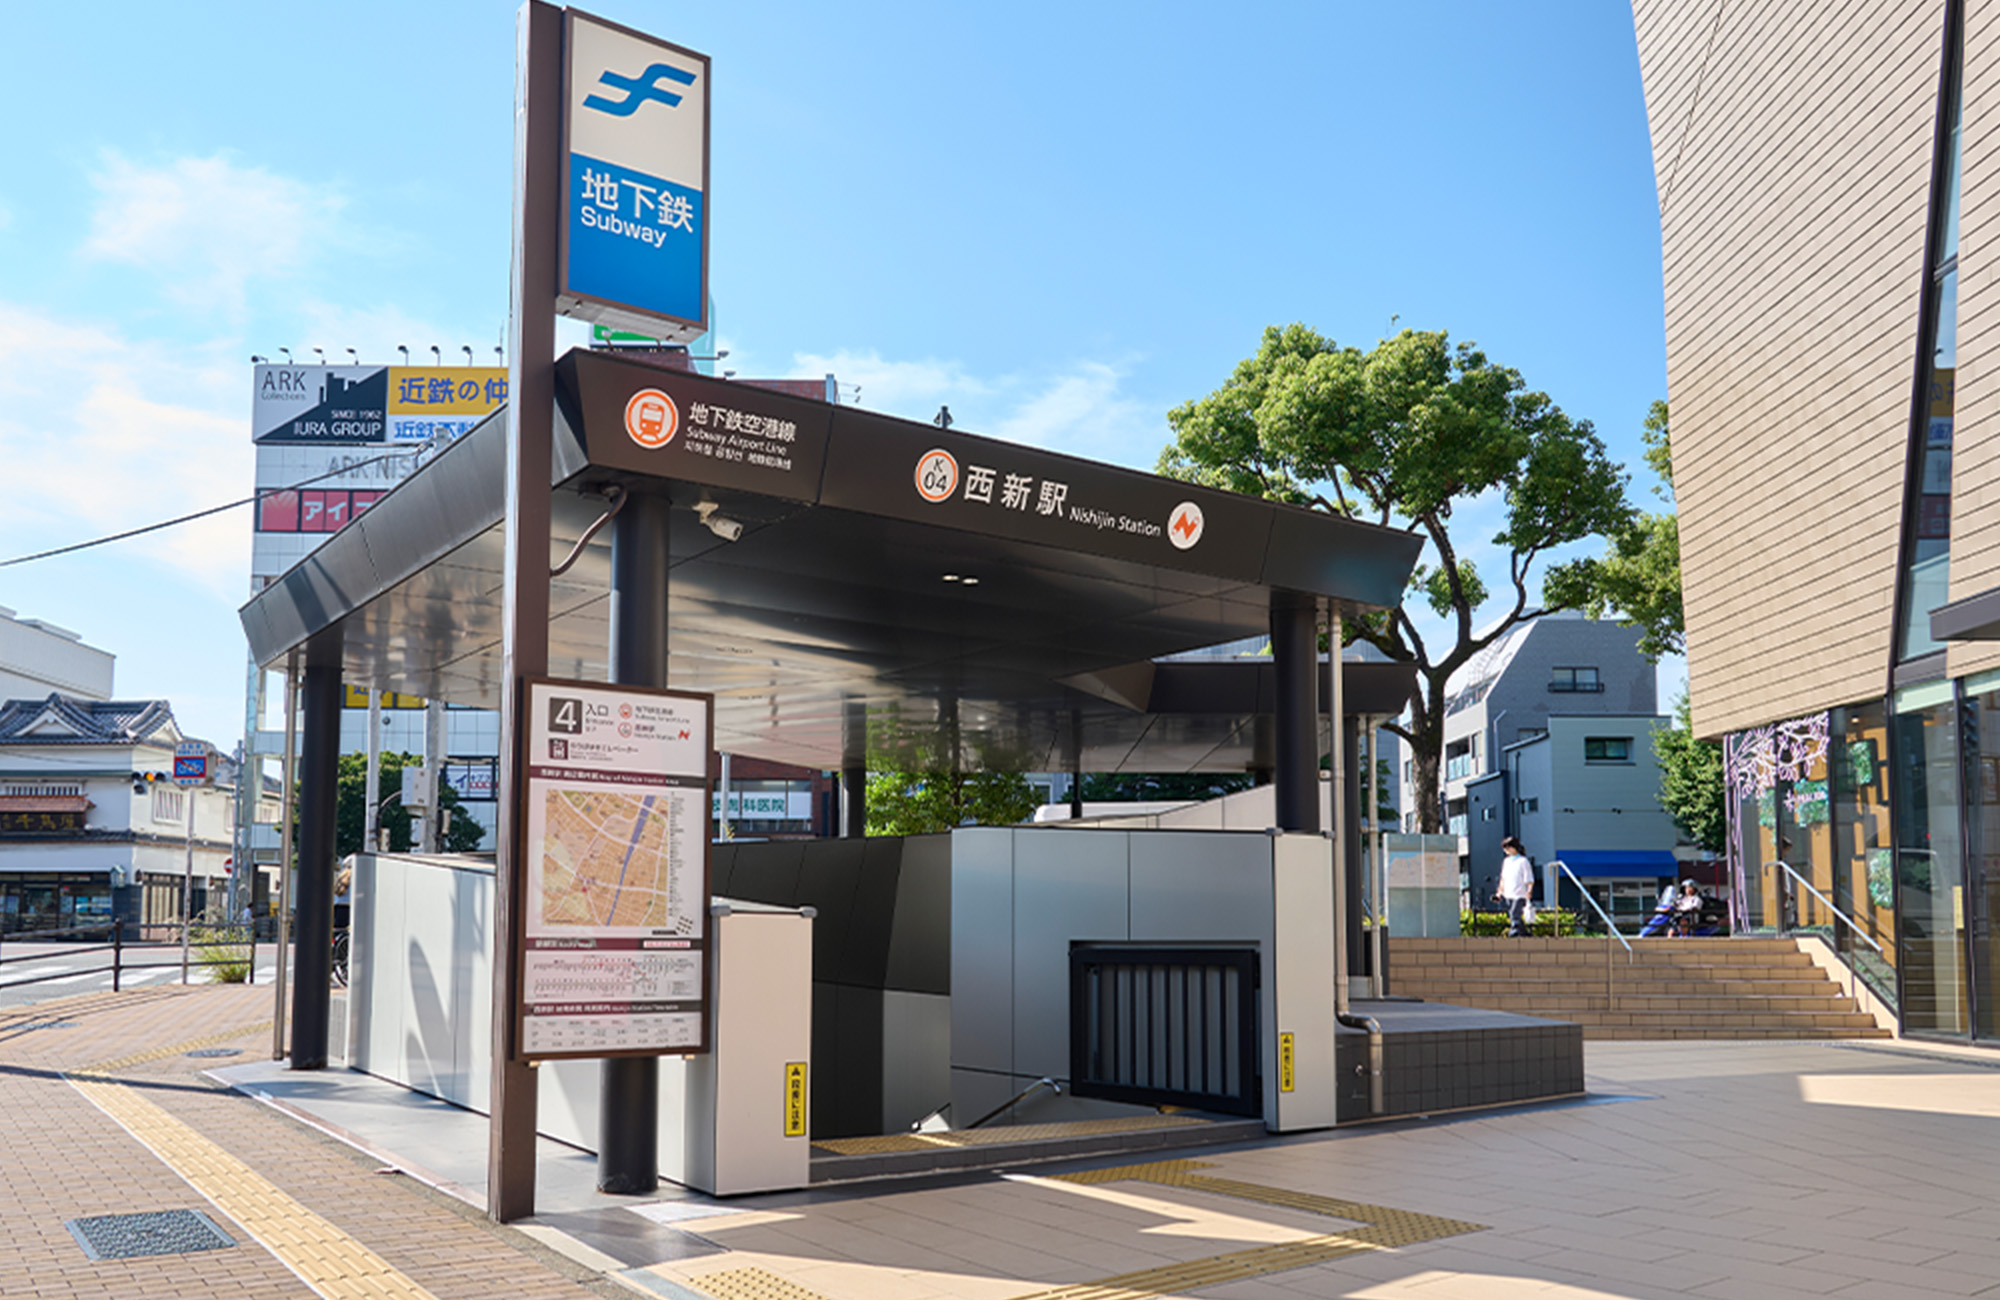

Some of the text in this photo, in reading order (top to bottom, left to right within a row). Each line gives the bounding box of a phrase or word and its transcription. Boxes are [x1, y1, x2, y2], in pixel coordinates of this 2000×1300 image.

[581, 167, 693, 233] 地下鉄
[581, 205, 667, 248] Subway
[262, 371, 306, 392] ARK
[331, 421, 382, 436] GROUP
[689, 401, 797, 443] 地下鉄空港線
[686, 425, 787, 457] Subway Airport Line
[933, 457, 945, 473] K
[924, 471, 947, 492] 04
[963, 465, 1069, 518] 西新駅
[1069, 506, 1161, 538] Nishijin Station
[554, 700, 577, 732] 4
[585, 703, 609, 717] 入口
